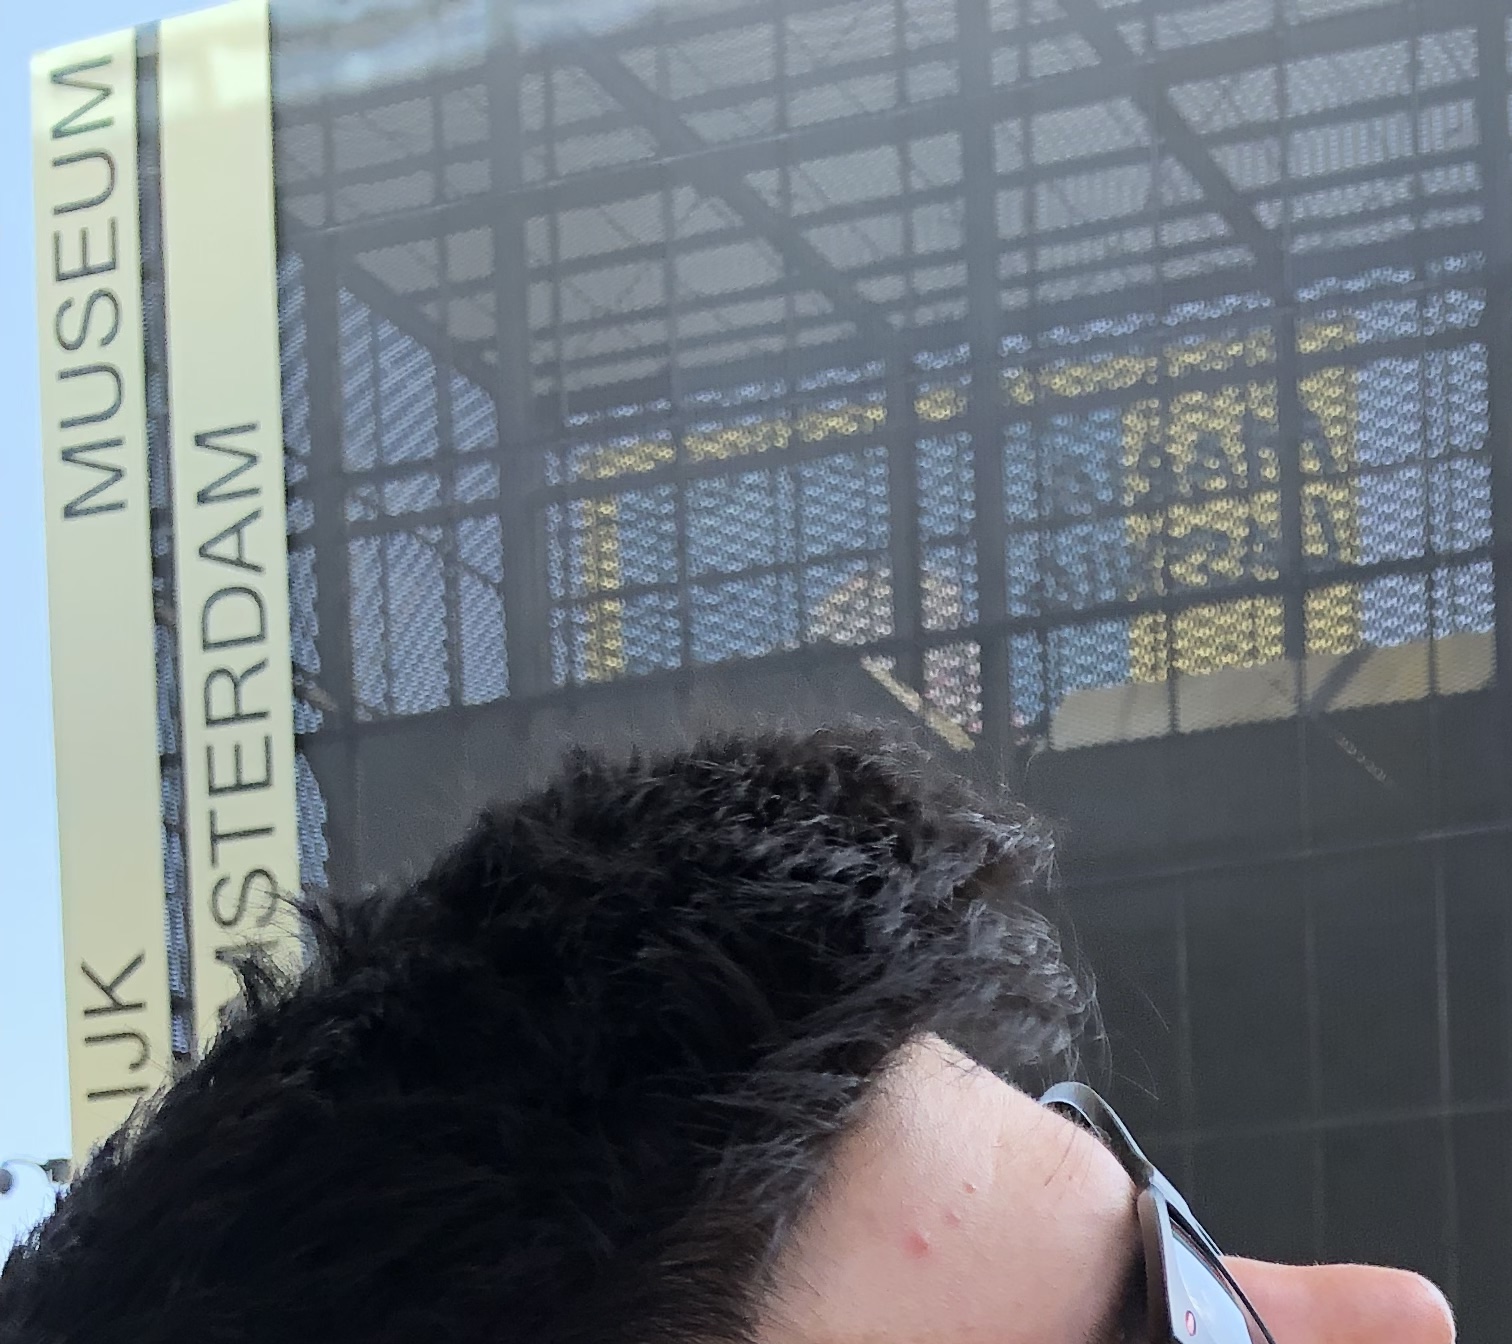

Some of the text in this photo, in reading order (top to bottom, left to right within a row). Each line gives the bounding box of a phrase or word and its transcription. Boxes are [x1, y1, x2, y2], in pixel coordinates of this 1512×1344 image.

[50, 54, 151, 1102] IJK MUSEUM
[194, 421, 279, 962] STERDAM
